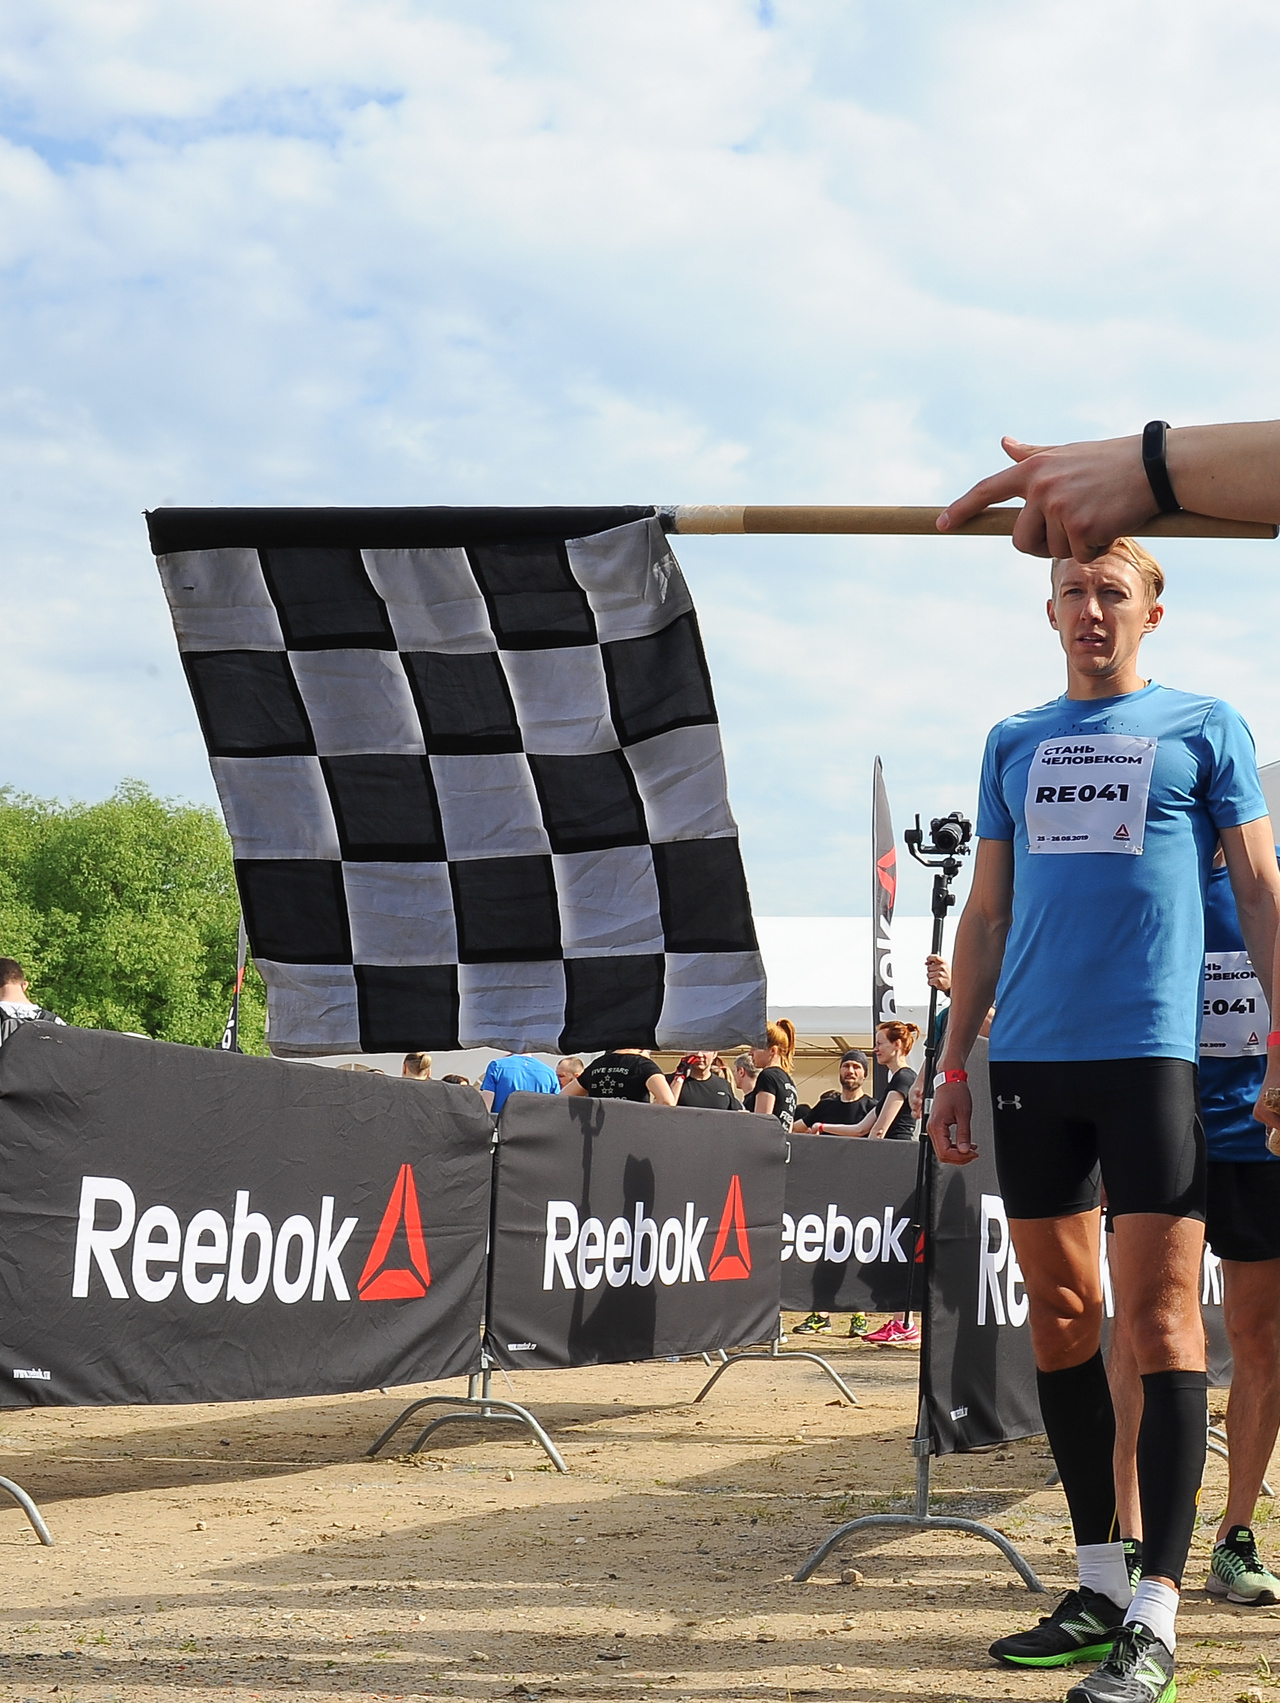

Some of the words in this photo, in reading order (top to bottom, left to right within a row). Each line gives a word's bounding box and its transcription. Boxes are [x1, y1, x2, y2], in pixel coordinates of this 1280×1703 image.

[1041, 755, 1142, 765] ЧЕЛОВЕКОМ
[1044, 745, 1096, 756] СТАНЬ
[1035, 784, 1130, 804] RE041
[591, 1067, 606, 1076] FIVE
[607, 1067, 630, 1076] STARS
[72, 1176, 360, 1305] Reebok
[780, 1203, 910, 1264] eebok
[542, 1199, 710, 1291] Reebok
